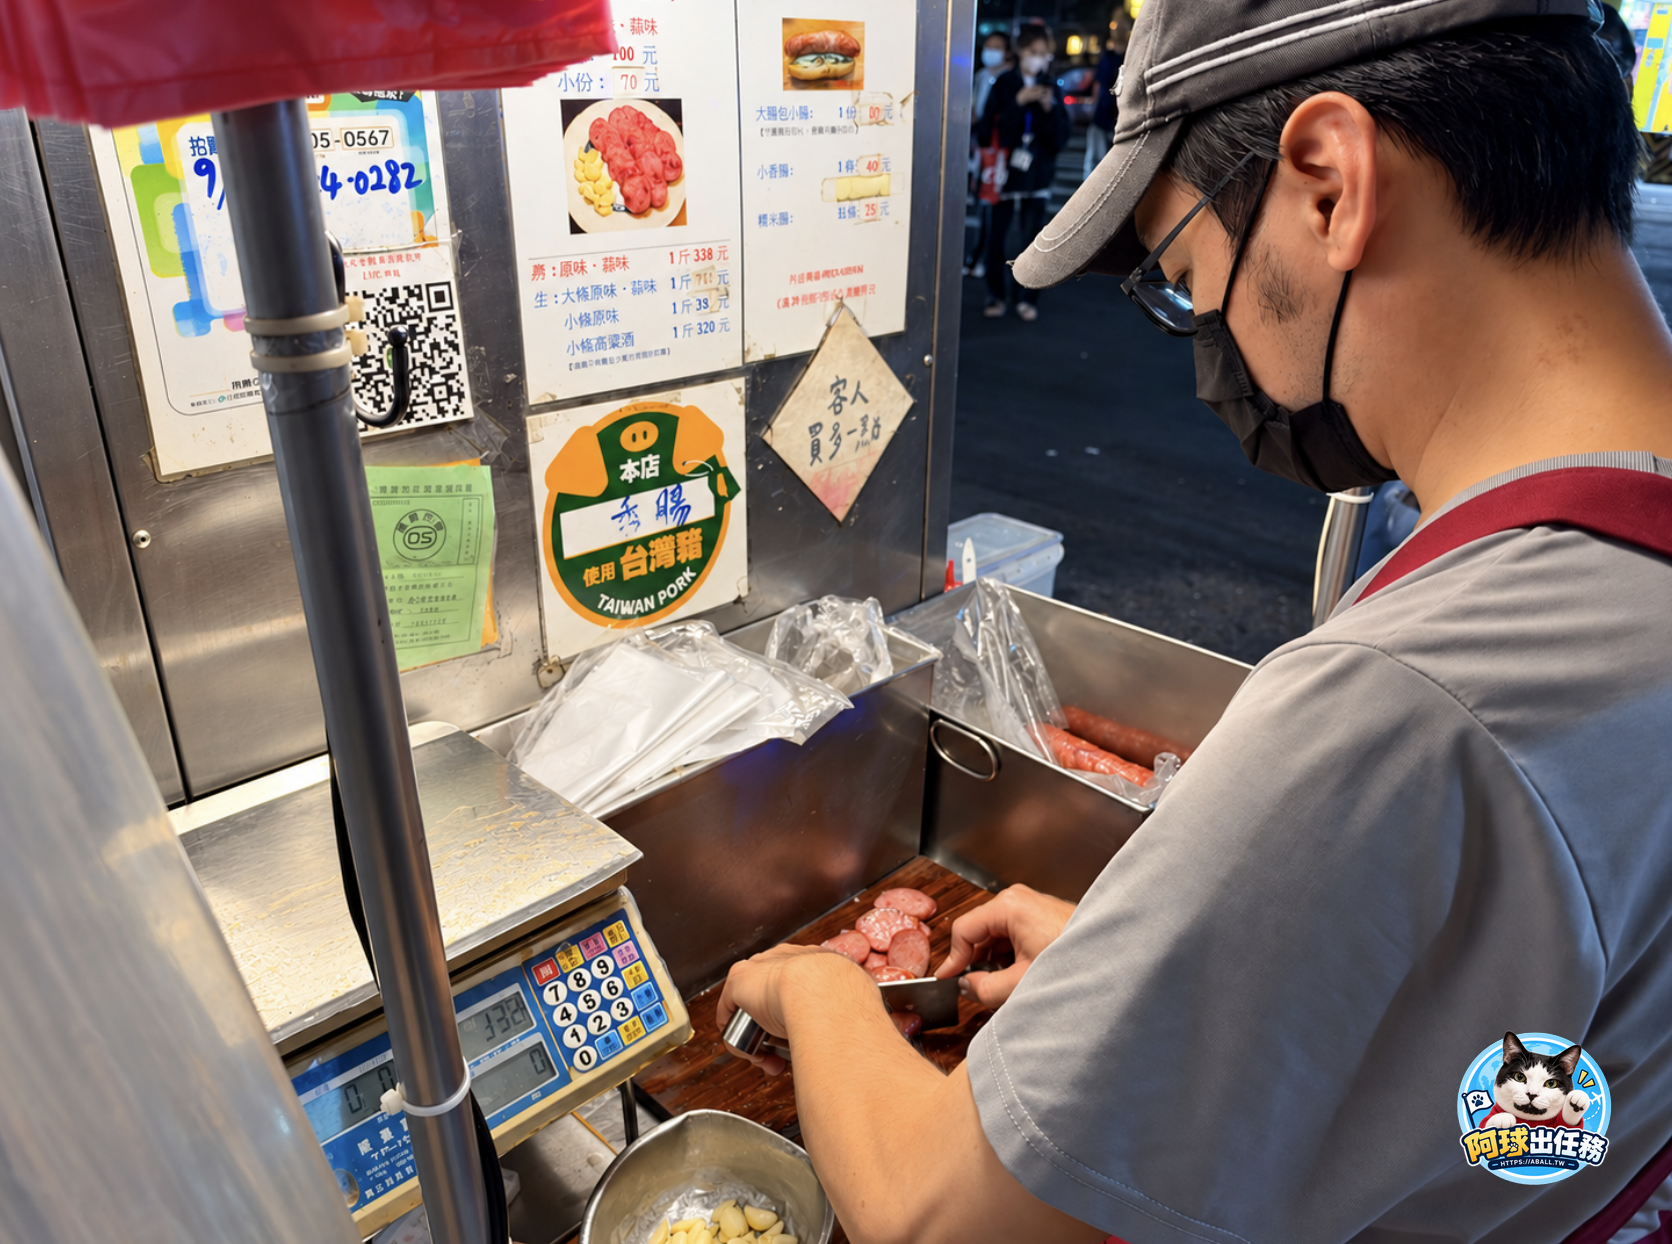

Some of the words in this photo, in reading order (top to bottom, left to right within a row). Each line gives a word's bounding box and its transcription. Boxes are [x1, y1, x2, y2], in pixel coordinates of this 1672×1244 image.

[827, 375, 869, 416] 客人
[808, 414, 882, 467] 買多一點
[619, 453, 661, 484] 本店
[597, 593, 655, 616] TAIWAN
[657, 566, 697, 605] PORK
[548, 984, 559, 1002] 7
[573, 971, 587, 989] 8
[596, 958, 610, 975] 9
[559, 1006, 573, 1022] 4
[582, 993, 596, 1010] 5
[606, 980, 619, 996] 6
[570, 1027, 582, 1043] 1
[592, 1015, 607, 1032] 2
[616, 1001, 630, 1017] 3
[578, 1049, 593, 1066] 0
